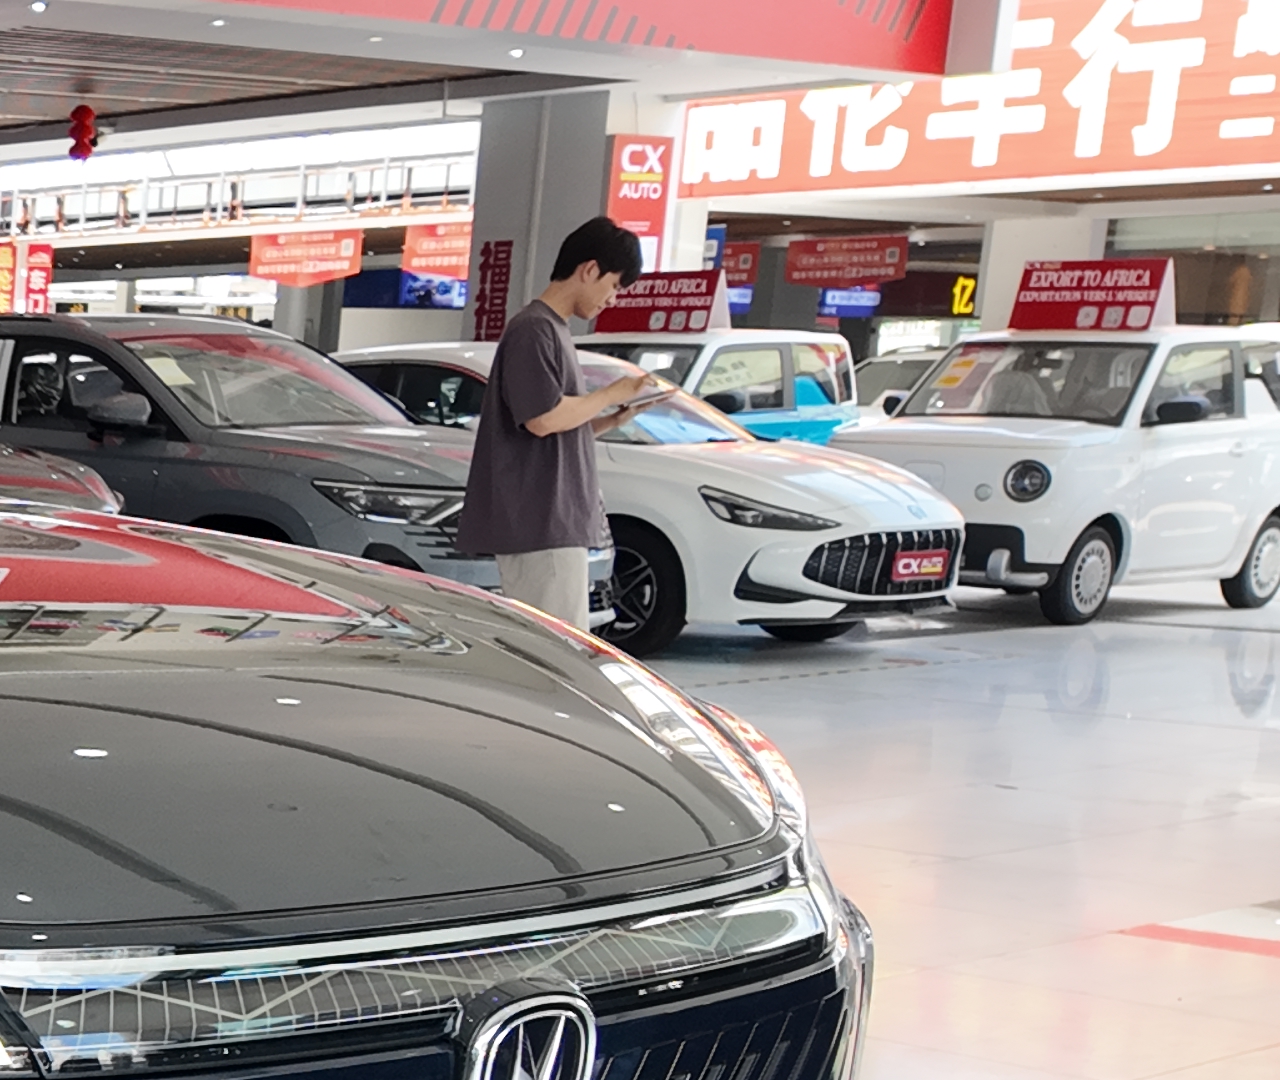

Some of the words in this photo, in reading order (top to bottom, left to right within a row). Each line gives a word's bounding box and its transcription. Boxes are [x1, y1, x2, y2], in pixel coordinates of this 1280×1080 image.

[620, 143, 666, 174] CX
[618, 182, 663, 200] AUTO
[653, 279, 669, 294] TO
[668, 278, 708, 294] AFRICA
[1028, 270, 1082, 288] EXPORT
[1081, 270, 1102, 288] TO
[1101, 268, 1151, 287] AFRICA
[897, 558, 921, 575] CX
